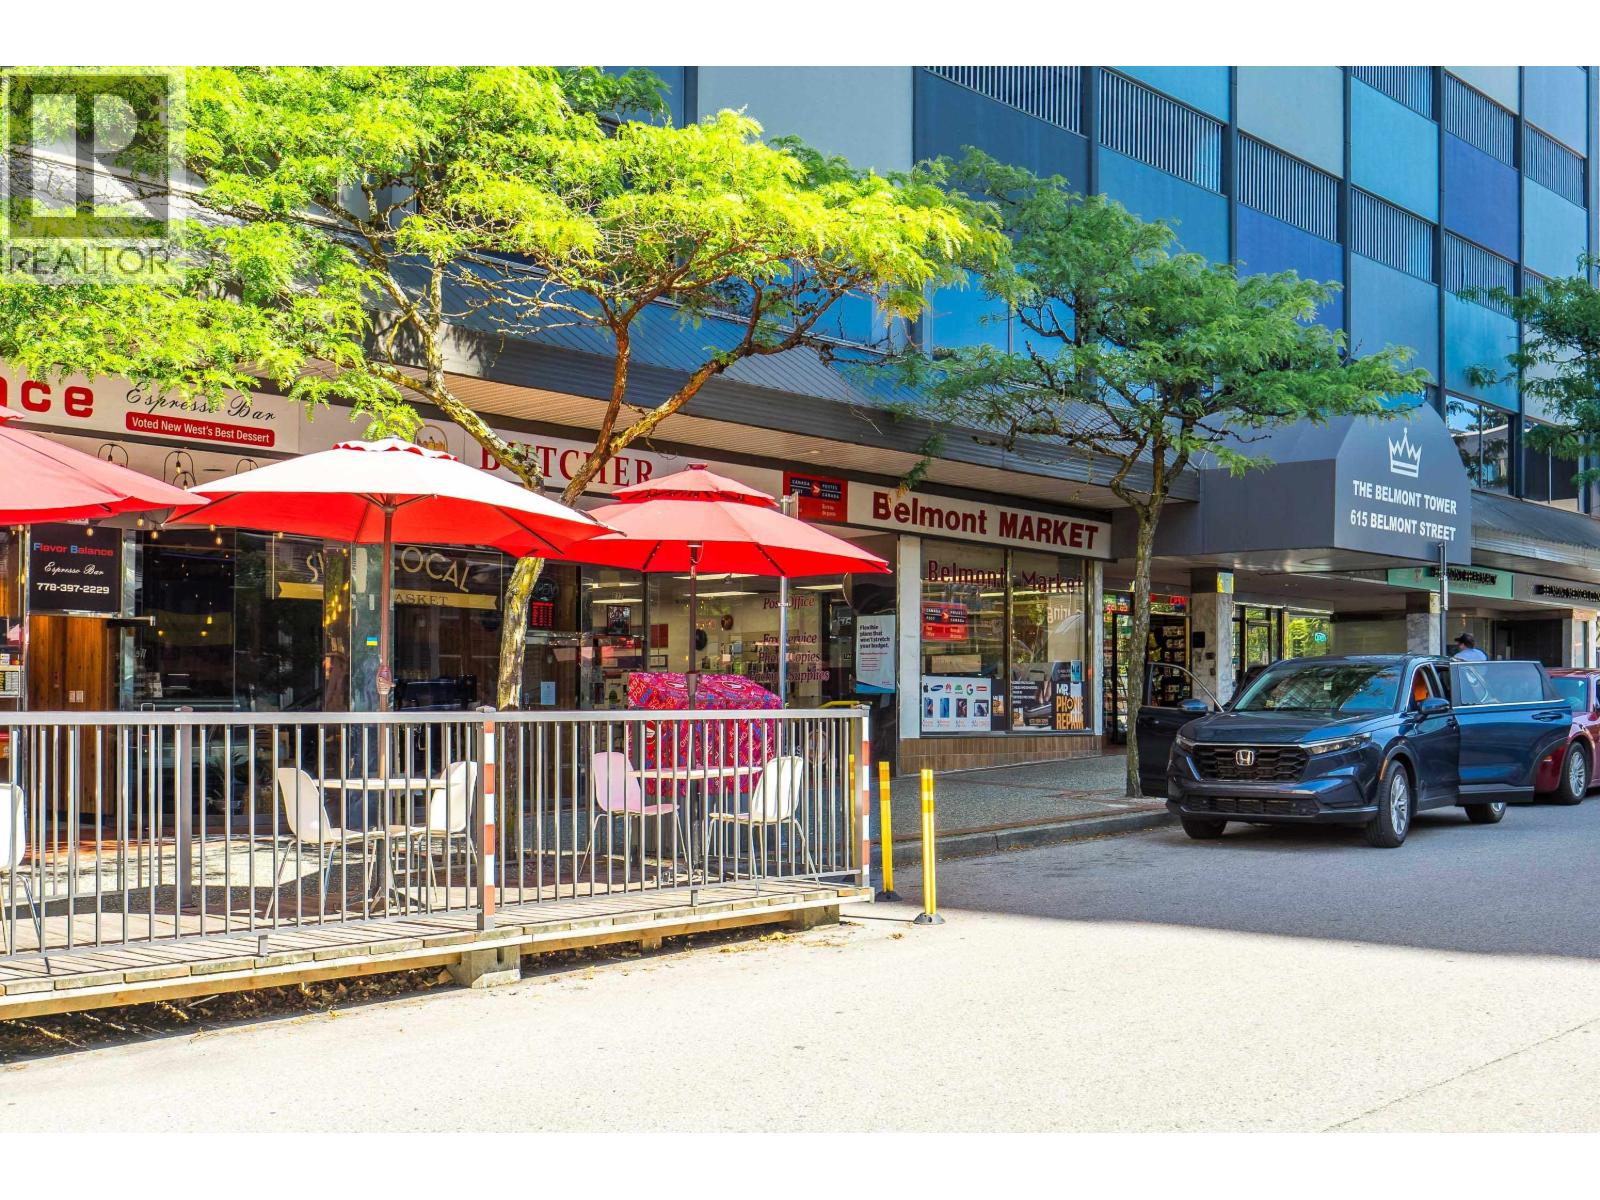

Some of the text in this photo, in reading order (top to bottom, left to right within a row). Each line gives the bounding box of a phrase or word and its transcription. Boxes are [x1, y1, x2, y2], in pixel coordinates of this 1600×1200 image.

[0, 376, 94, 418] ce
[227, 395, 277, 421] Bar
[132, 416, 270, 444] Voted New West's Best Dessert
[1352, 479, 1457, 515] THE BELMONT TOWER
[872, 490, 1099, 550] Belmont MARKET
[1350, 509, 1456, 541] 615 BELMONT STREET
[33, 542, 114, 557] Flavor Balance
[44, 561, 104, 576] Espresso Bar
[395, 546, 470, 593] OCAL
[928, 559, 1084, 593] Belmont Market
[36, 582, 110, 595] 778-397-2229
[395, 593, 448, 607] ASKET
[763, 597, 783, 610] Pos
[1056, 695, 1084, 713] PHONE
[1056, 712, 1085, 730] REPAIR
